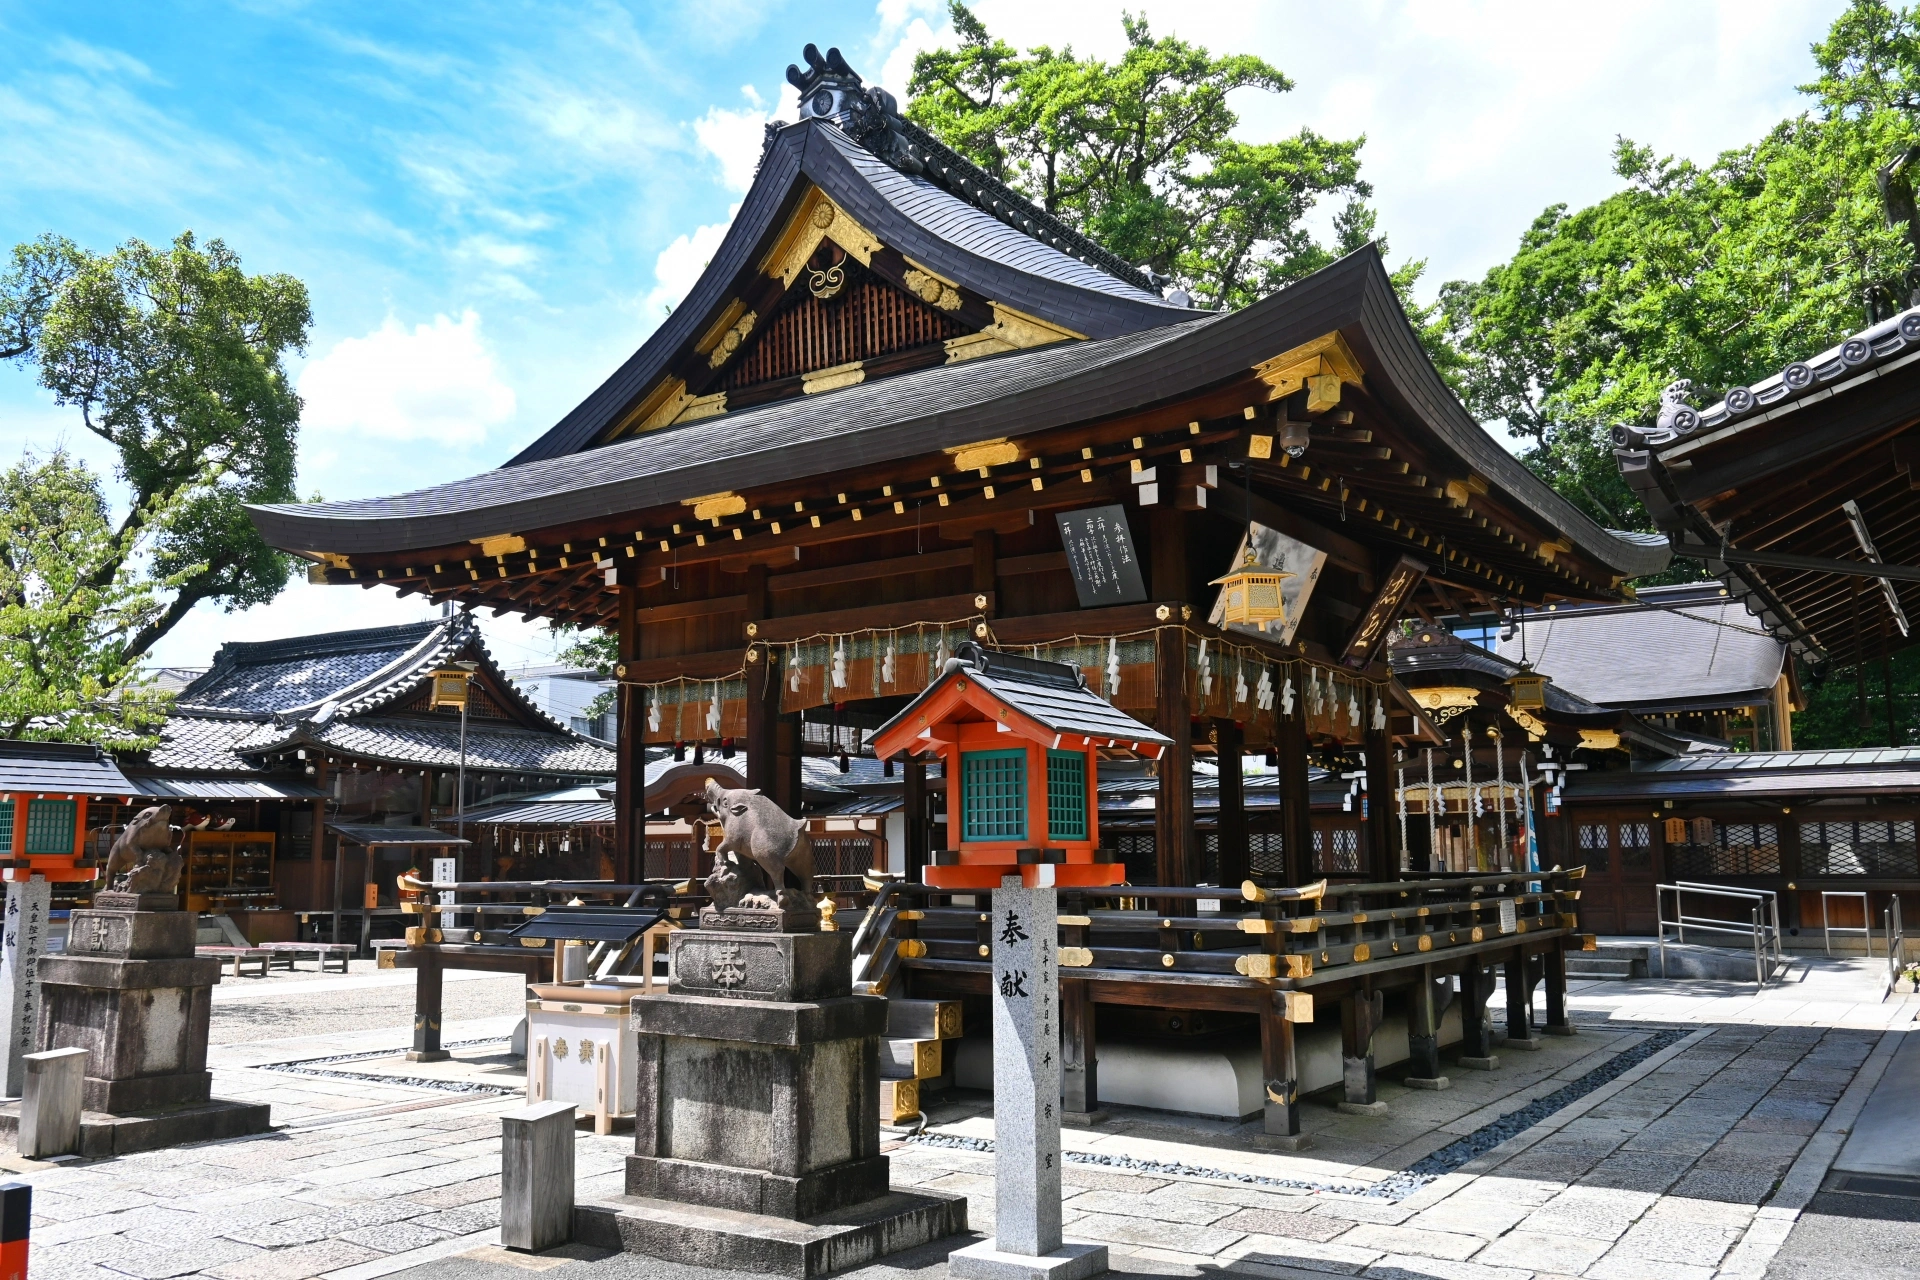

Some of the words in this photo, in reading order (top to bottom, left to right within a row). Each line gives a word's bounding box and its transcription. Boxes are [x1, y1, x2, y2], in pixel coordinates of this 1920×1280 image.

[1114, 522, 1132, 564] 参拝作法
[5, 895, 19, 947] 奉献
[20, 902, 40, 1048] 天皇陛下御即位十年奉祝記念
[711, 941, 746, 989] 奉
[998, 910, 1029, 998] 奉献
